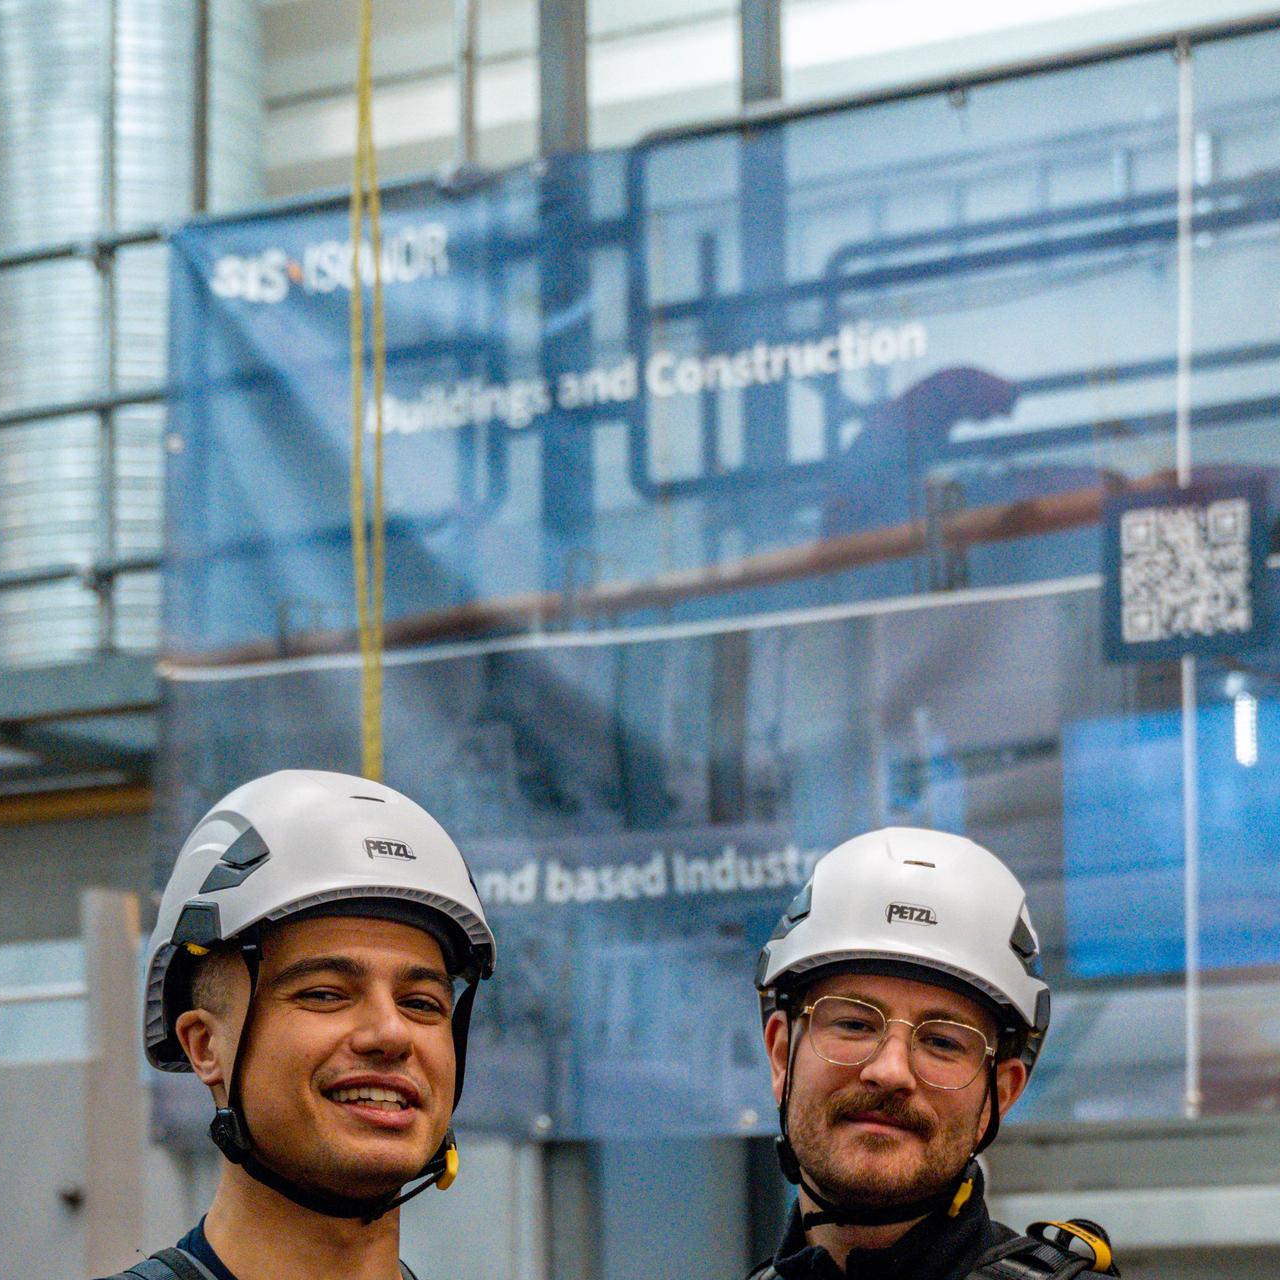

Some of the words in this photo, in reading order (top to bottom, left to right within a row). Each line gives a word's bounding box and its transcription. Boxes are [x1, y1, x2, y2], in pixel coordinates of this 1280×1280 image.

[365, 372, 552, 433] Buildings
[558, 354, 638, 408] and
[646, 321, 928, 397] Construction
[364, 839, 417, 860] PETZL
[480, 861, 538, 904] nd
[545, 850, 667, 903] based
[887, 903, 939, 925] PETZL
